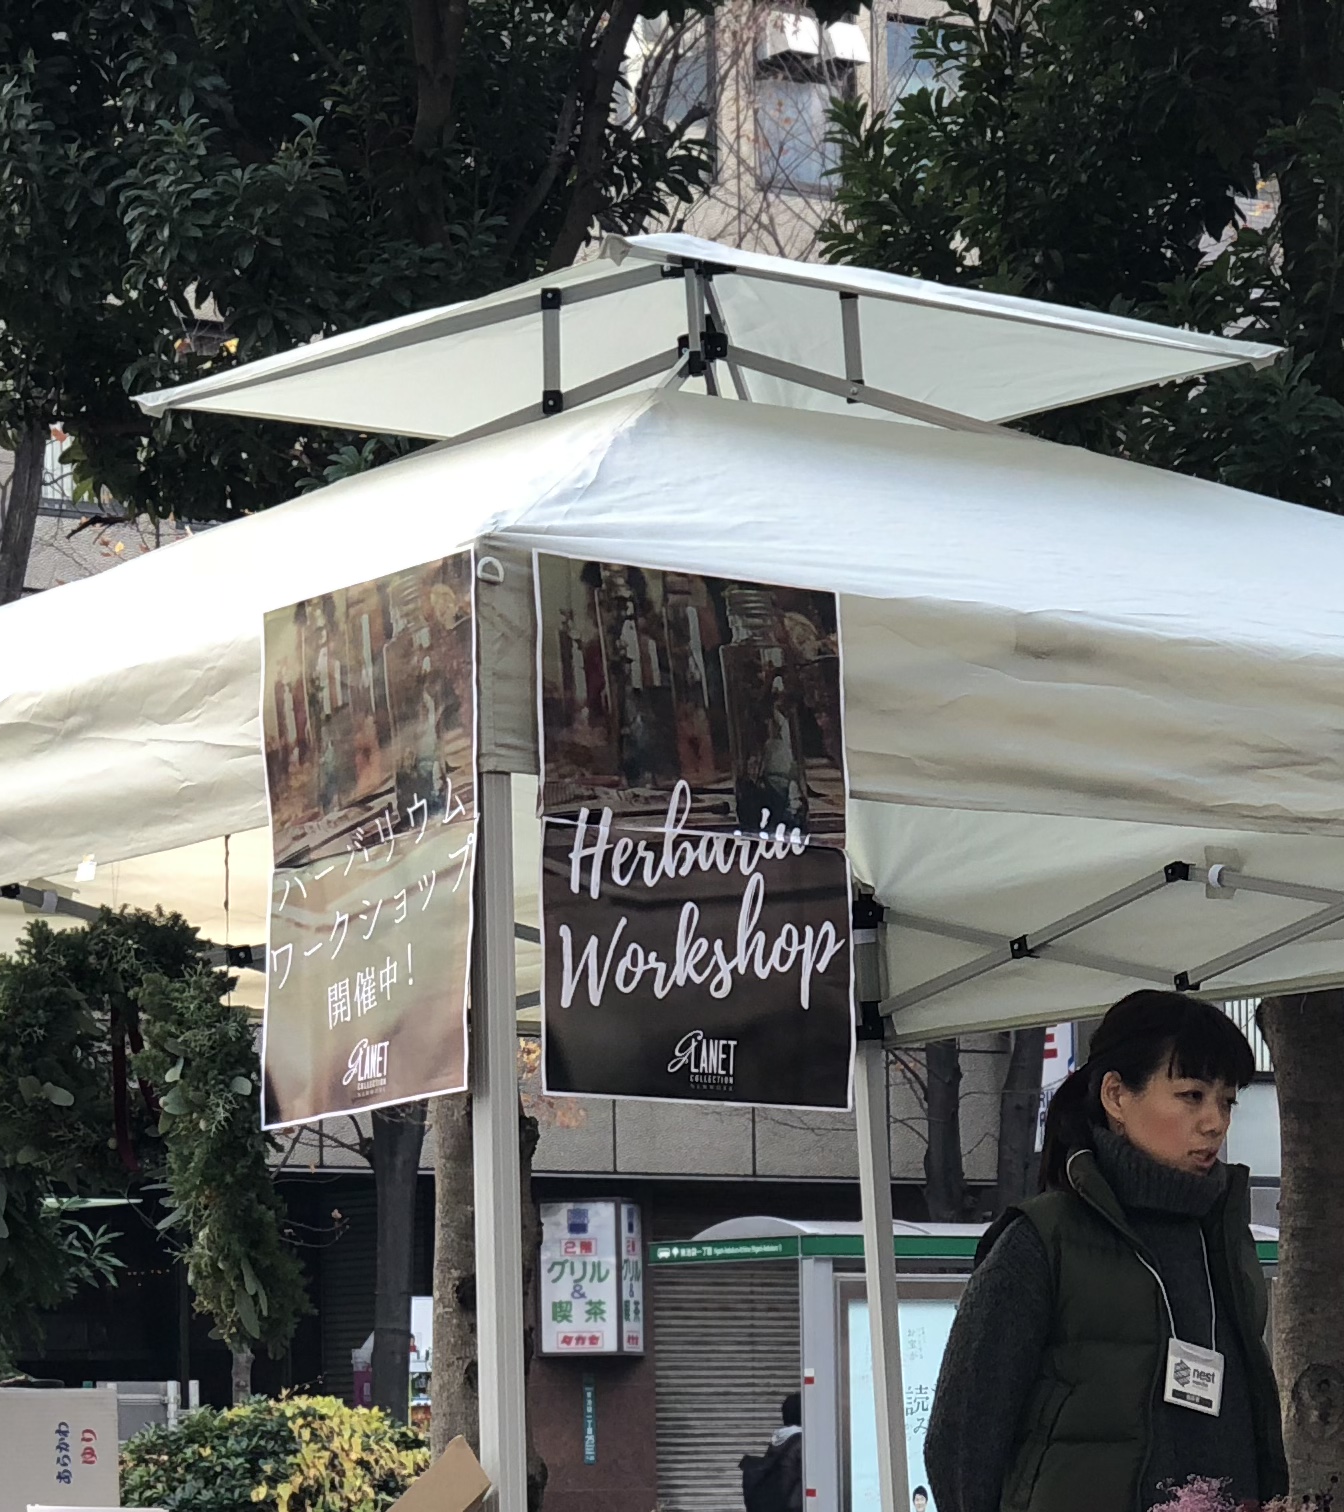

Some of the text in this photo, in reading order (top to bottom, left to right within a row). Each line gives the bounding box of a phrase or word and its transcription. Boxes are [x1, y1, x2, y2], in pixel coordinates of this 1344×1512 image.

[279, 777, 466, 911] ハーバリウム
[271, 833, 476, 989] ワークショップ
[559, 872, 845, 1010] Workshop
[690, 1074, 734, 1085] COLLECTION
[547, 1259, 610, 1284] グリル
[571, 1284, 587, 1300] &
[552, 1299, 606, 1324] 喫茶
[1192, 1368, 1215, 1384] nest
[55, 1421, 73, 1485] あらかわ
[80, 1428, 98, 1465] ゆり
